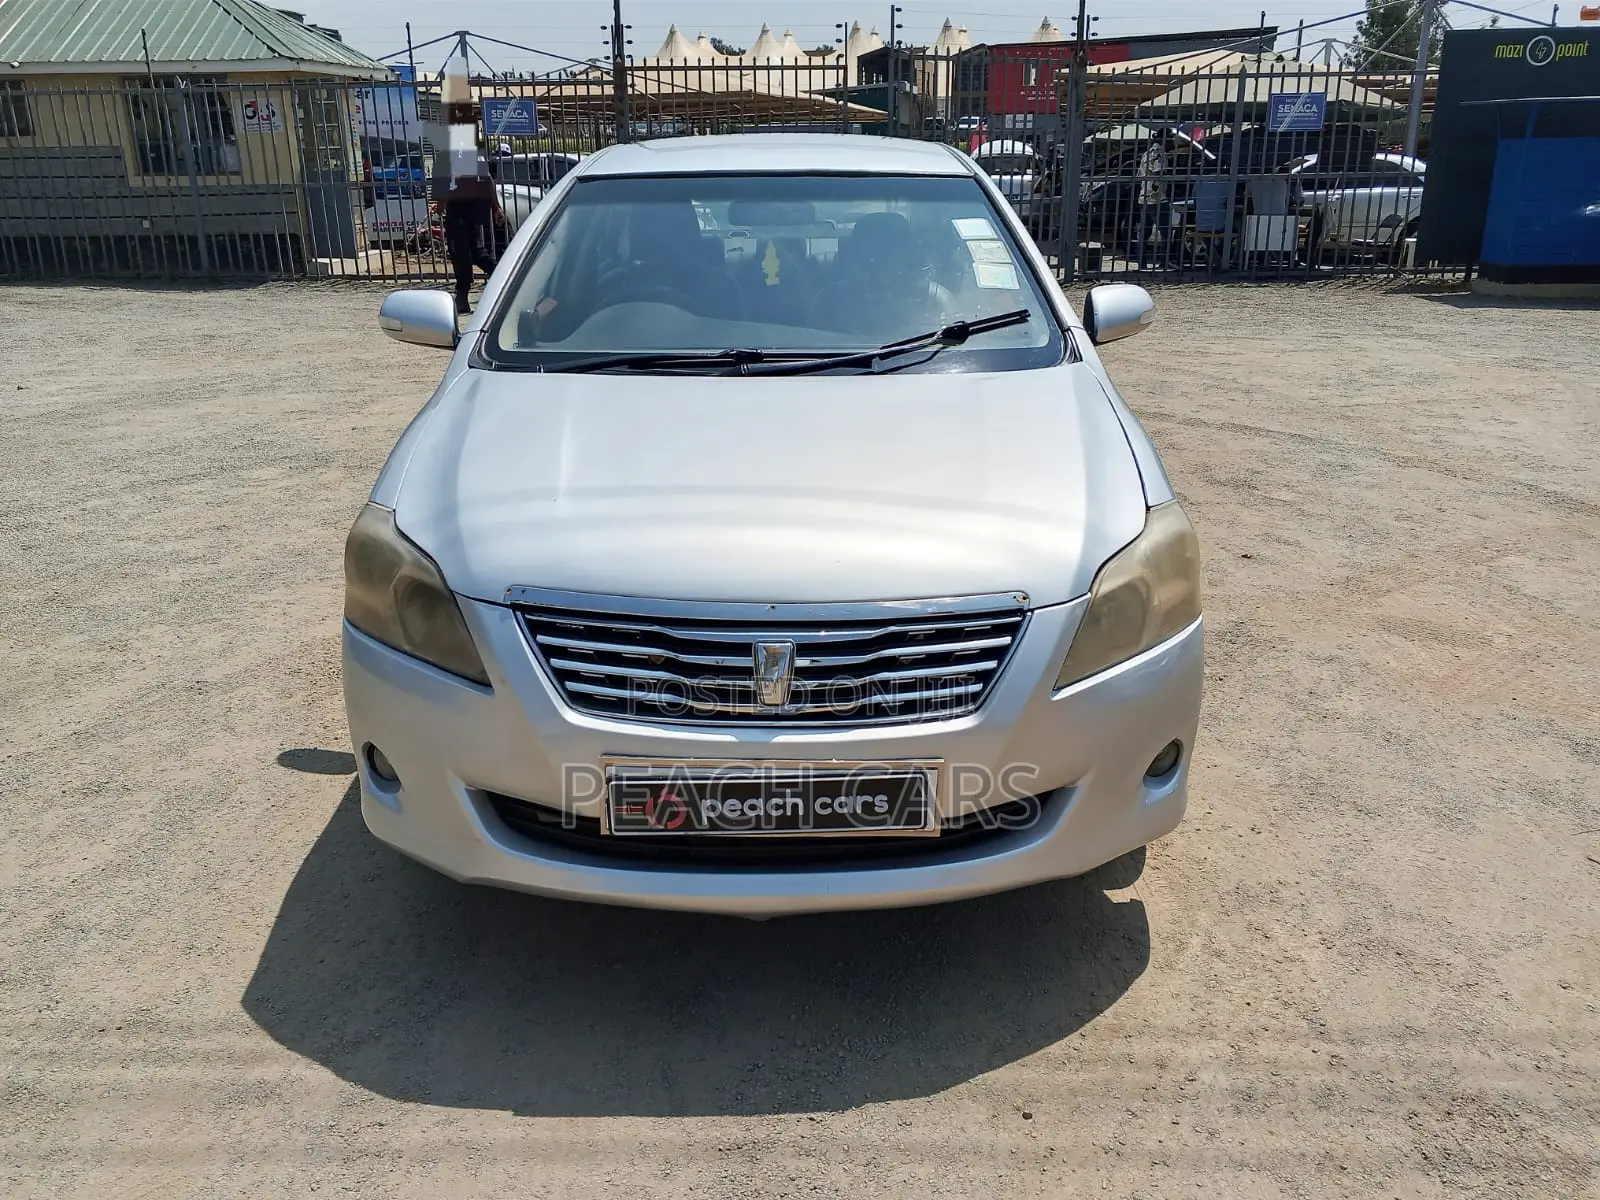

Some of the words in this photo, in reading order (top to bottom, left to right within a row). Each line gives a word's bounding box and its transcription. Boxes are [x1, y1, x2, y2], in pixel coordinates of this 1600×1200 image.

[1555, 40, 1590, 61] point
[491, 109, 529, 118] SENACA
[1277, 104, 1318, 113] SENACA
[701, 788, 805, 827] peach
[814, 793, 889, 815] cars
